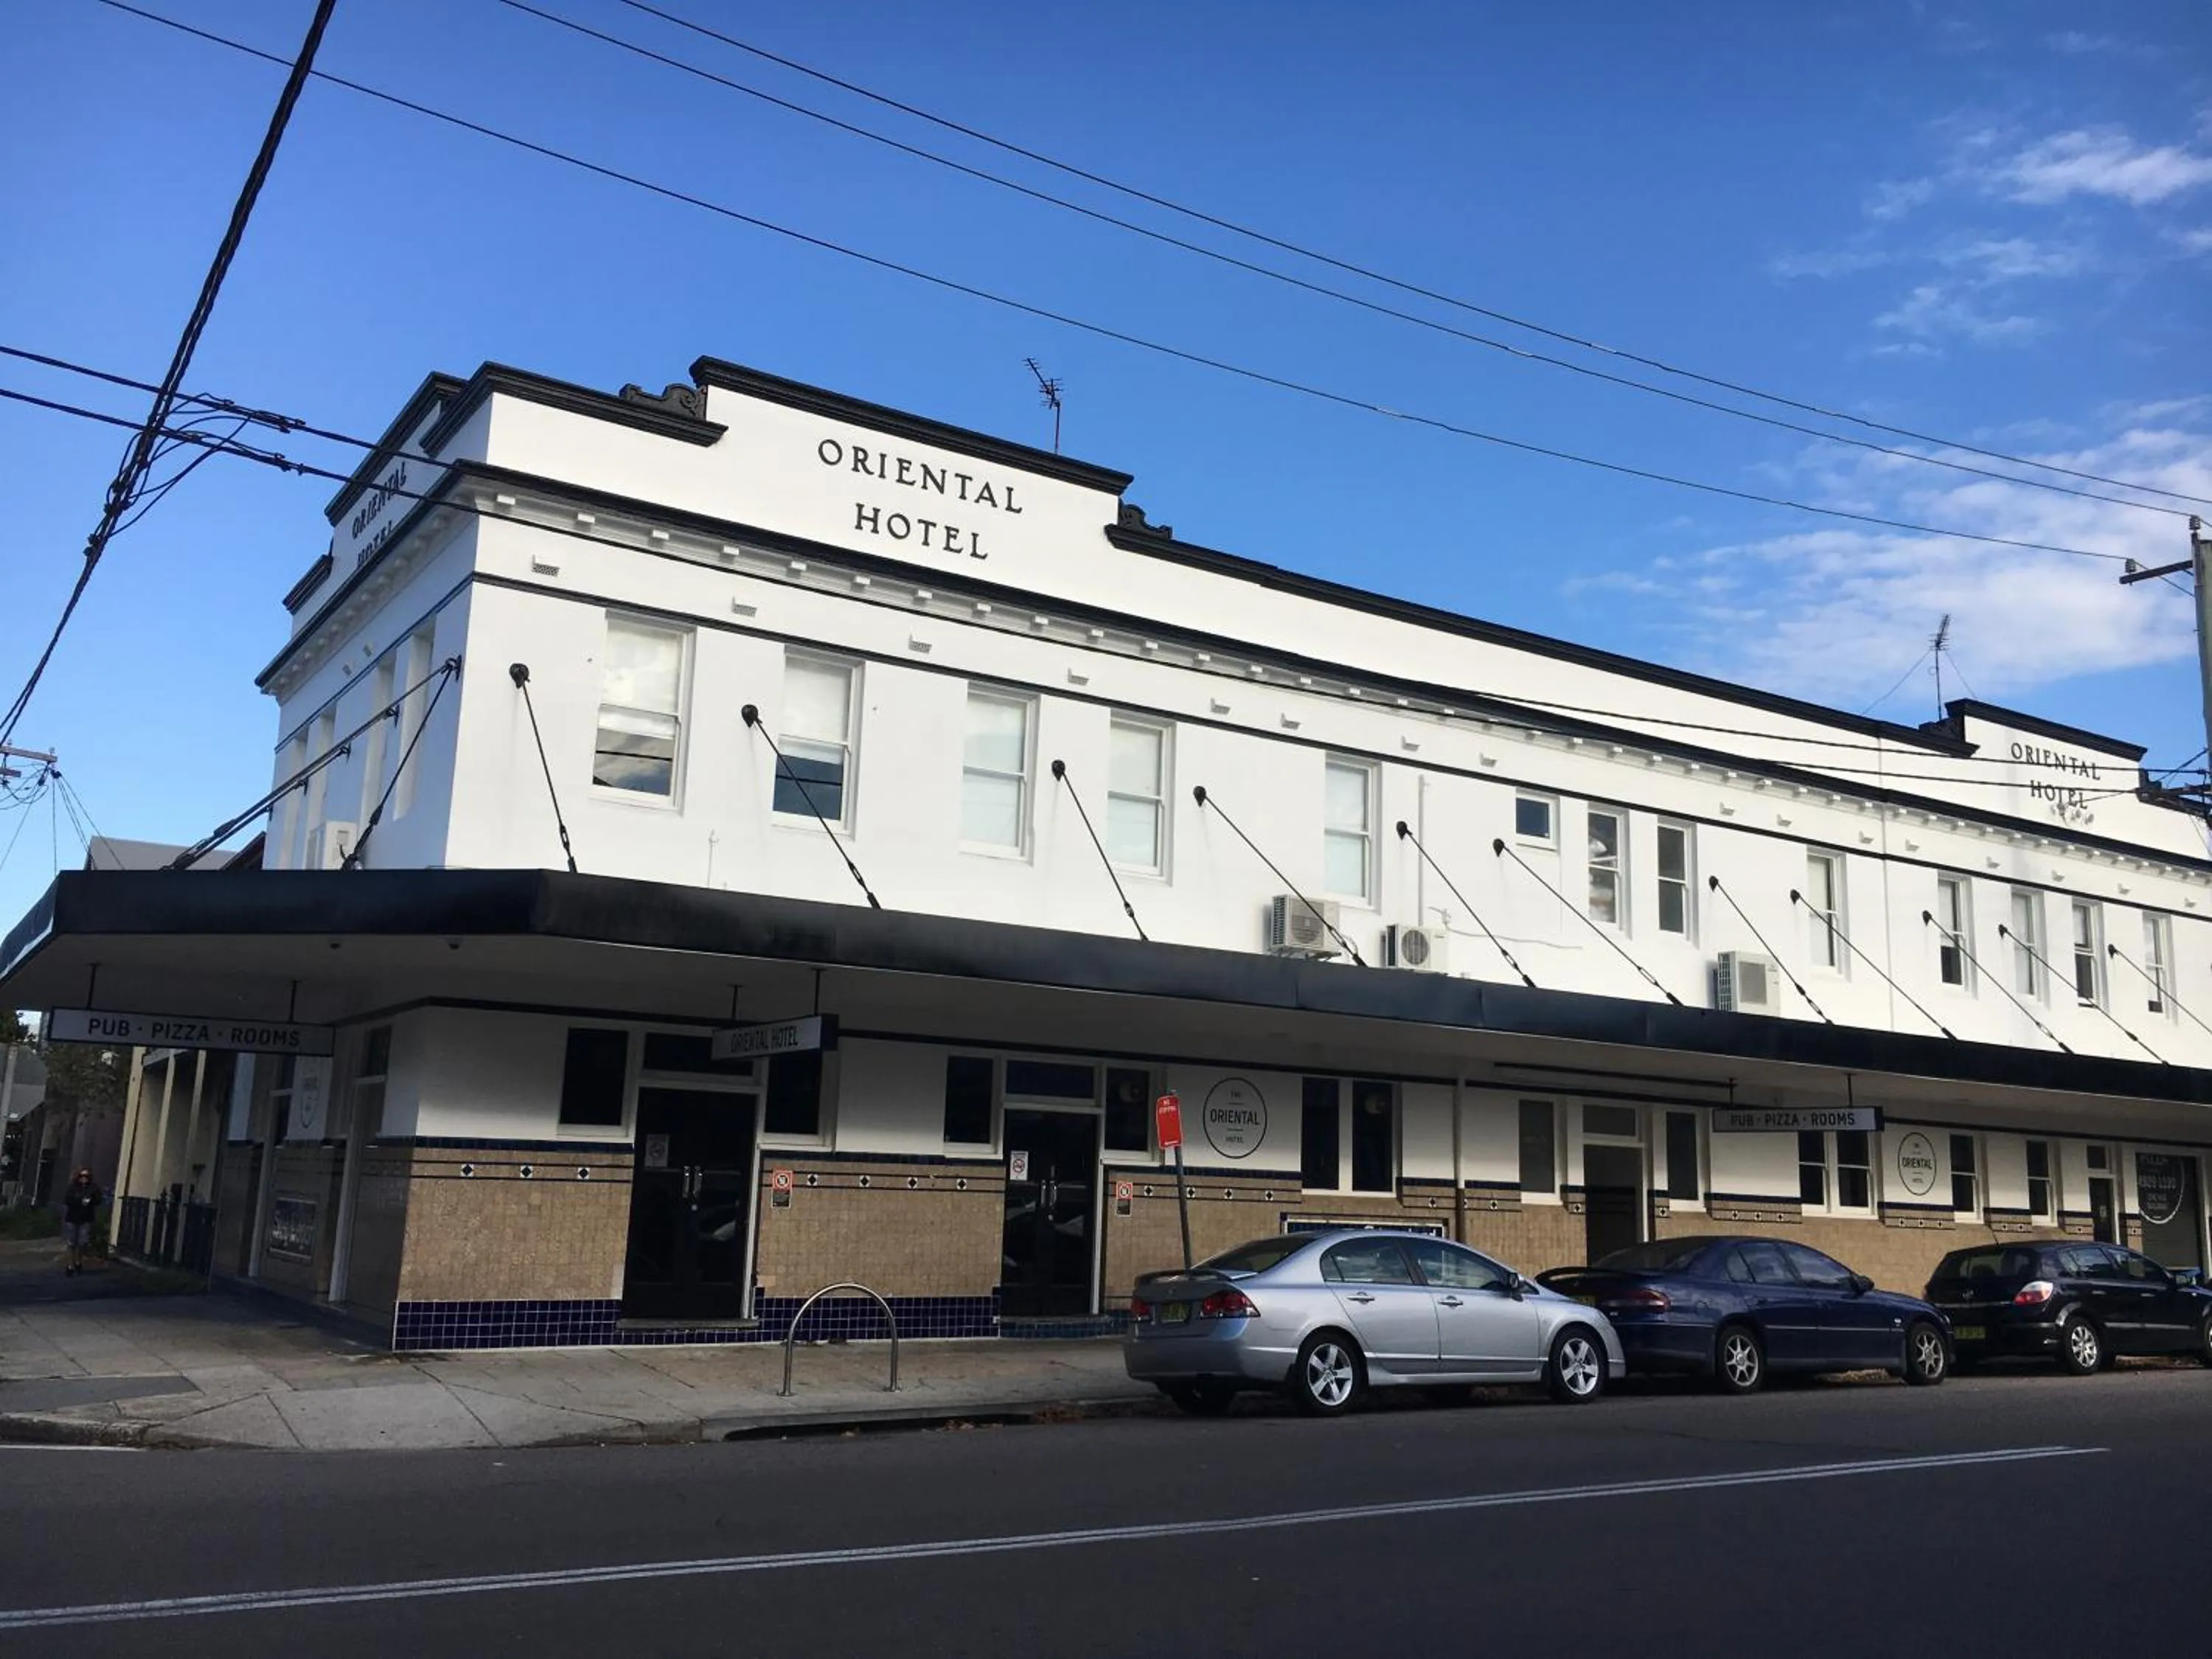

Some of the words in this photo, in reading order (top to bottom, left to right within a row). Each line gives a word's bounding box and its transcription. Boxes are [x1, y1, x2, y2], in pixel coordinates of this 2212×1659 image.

[818, 439, 1023, 514] ORIENTAL
[352, 462, 407, 540] ORIENTAL
[855, 503, 988, 560] HOTEL
[2011, 742, 2100, 781] ORIENTAL
[2031, 780, 2088, 810] HOTEL
[88, 1018, 130, 1036] PUB
[151, 1022, 210, 1041] PIZZA
[231, 1028, 301, 1047] ROOMS
[771, 1026, 799, 1048] HOTEL
[1210, 1108, 1260, 1126] ORIENTAL
[1731, 1113, 1754, 1127] PUB
[1764, 1112, 1798, 1126] PIZZA
[1811, 1112, 1855, 1126] ROOMS
